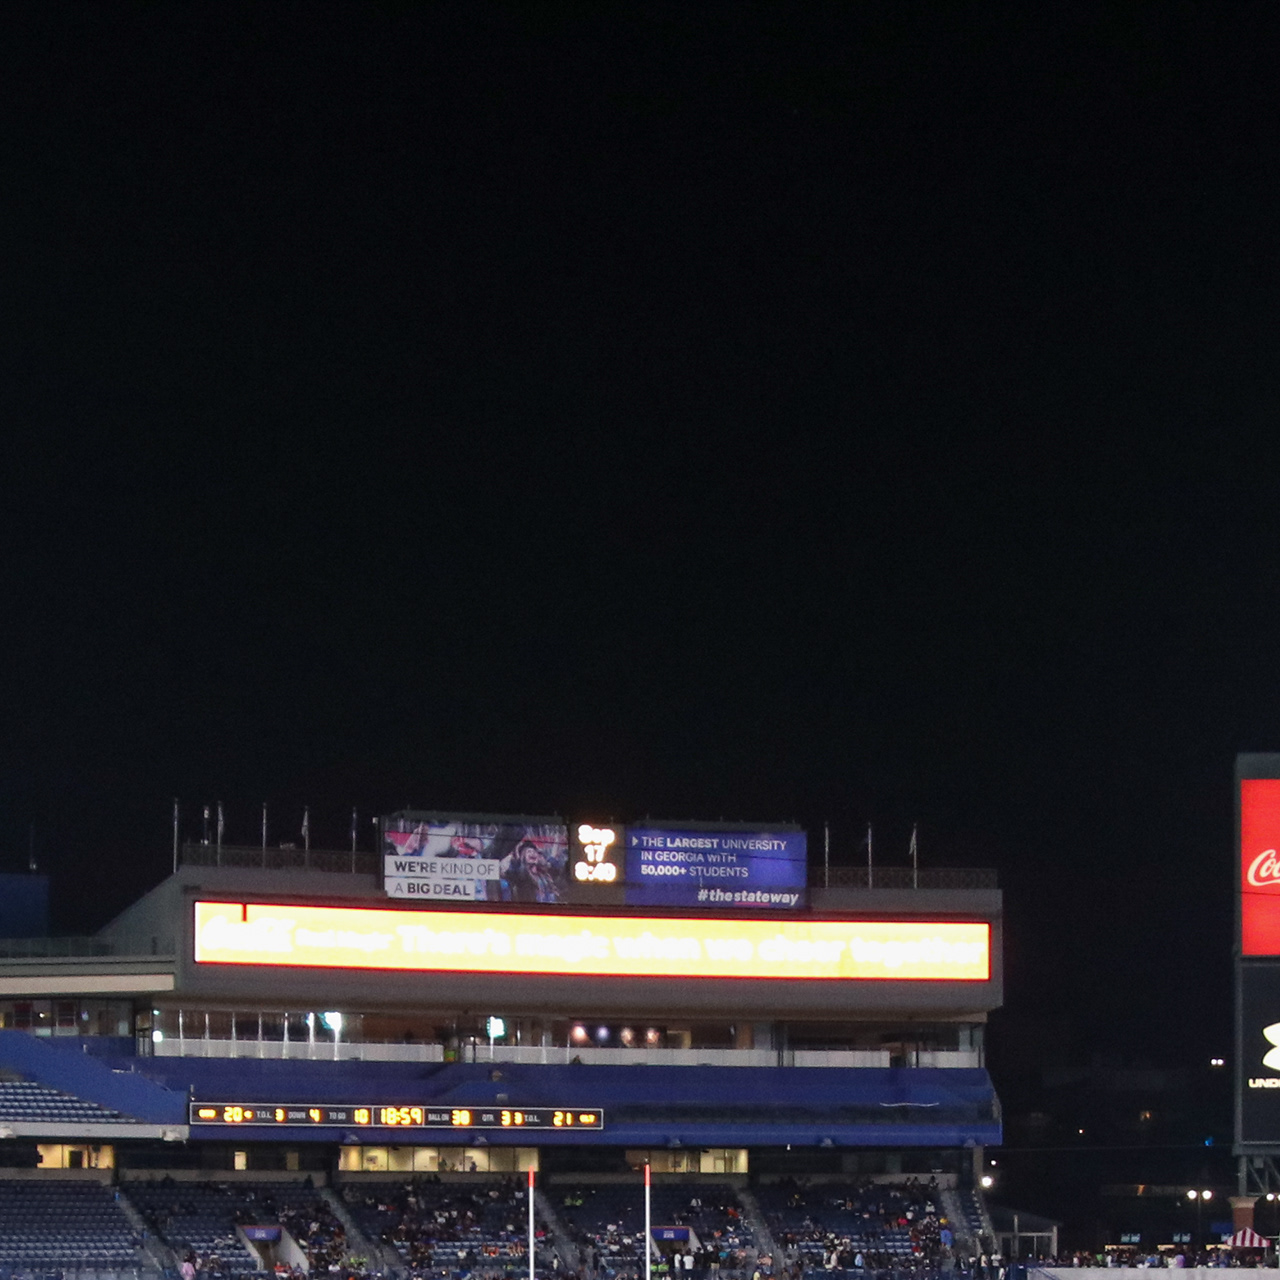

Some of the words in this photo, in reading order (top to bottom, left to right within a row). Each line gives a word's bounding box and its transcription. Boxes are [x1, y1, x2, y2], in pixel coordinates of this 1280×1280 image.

[578, 825, 615, 846] Sep
[641, 837, 664, 847] THE
[666, 838, 719, 849] LARGEST
[722, 840, 787, 851] UNIVERSITY
[584, 845, 607, 862] 17
[641, 851, 652, 861] IN
[655, 851, 704, 863] GEORGIA
[394, 860, 437, 873] WE'RE
[440, 862, 473, 875] KIND
[477, 863, 495, 875] OF
[641, 866, 687, 877] 50,000+
[689, 867, 749, 877] STUDENTS
[394, 882, 404, 894] A
[407, 883, 430, 894] BIG
[433, 884, 471, 895] DEAL
[698, 889, 799, 906] #thestateway
[223, 1107, 243, 1123] 20
[275, 1108, 285, 1122] 3
[309, 1108, 320, 1122] 4
[354, 1108, 370, 1124] 10
[380, 1107, 422, 1125] 18:59
[501, 1110, 512, 1126] 3
[553, 1111, 573, 1126] 21
